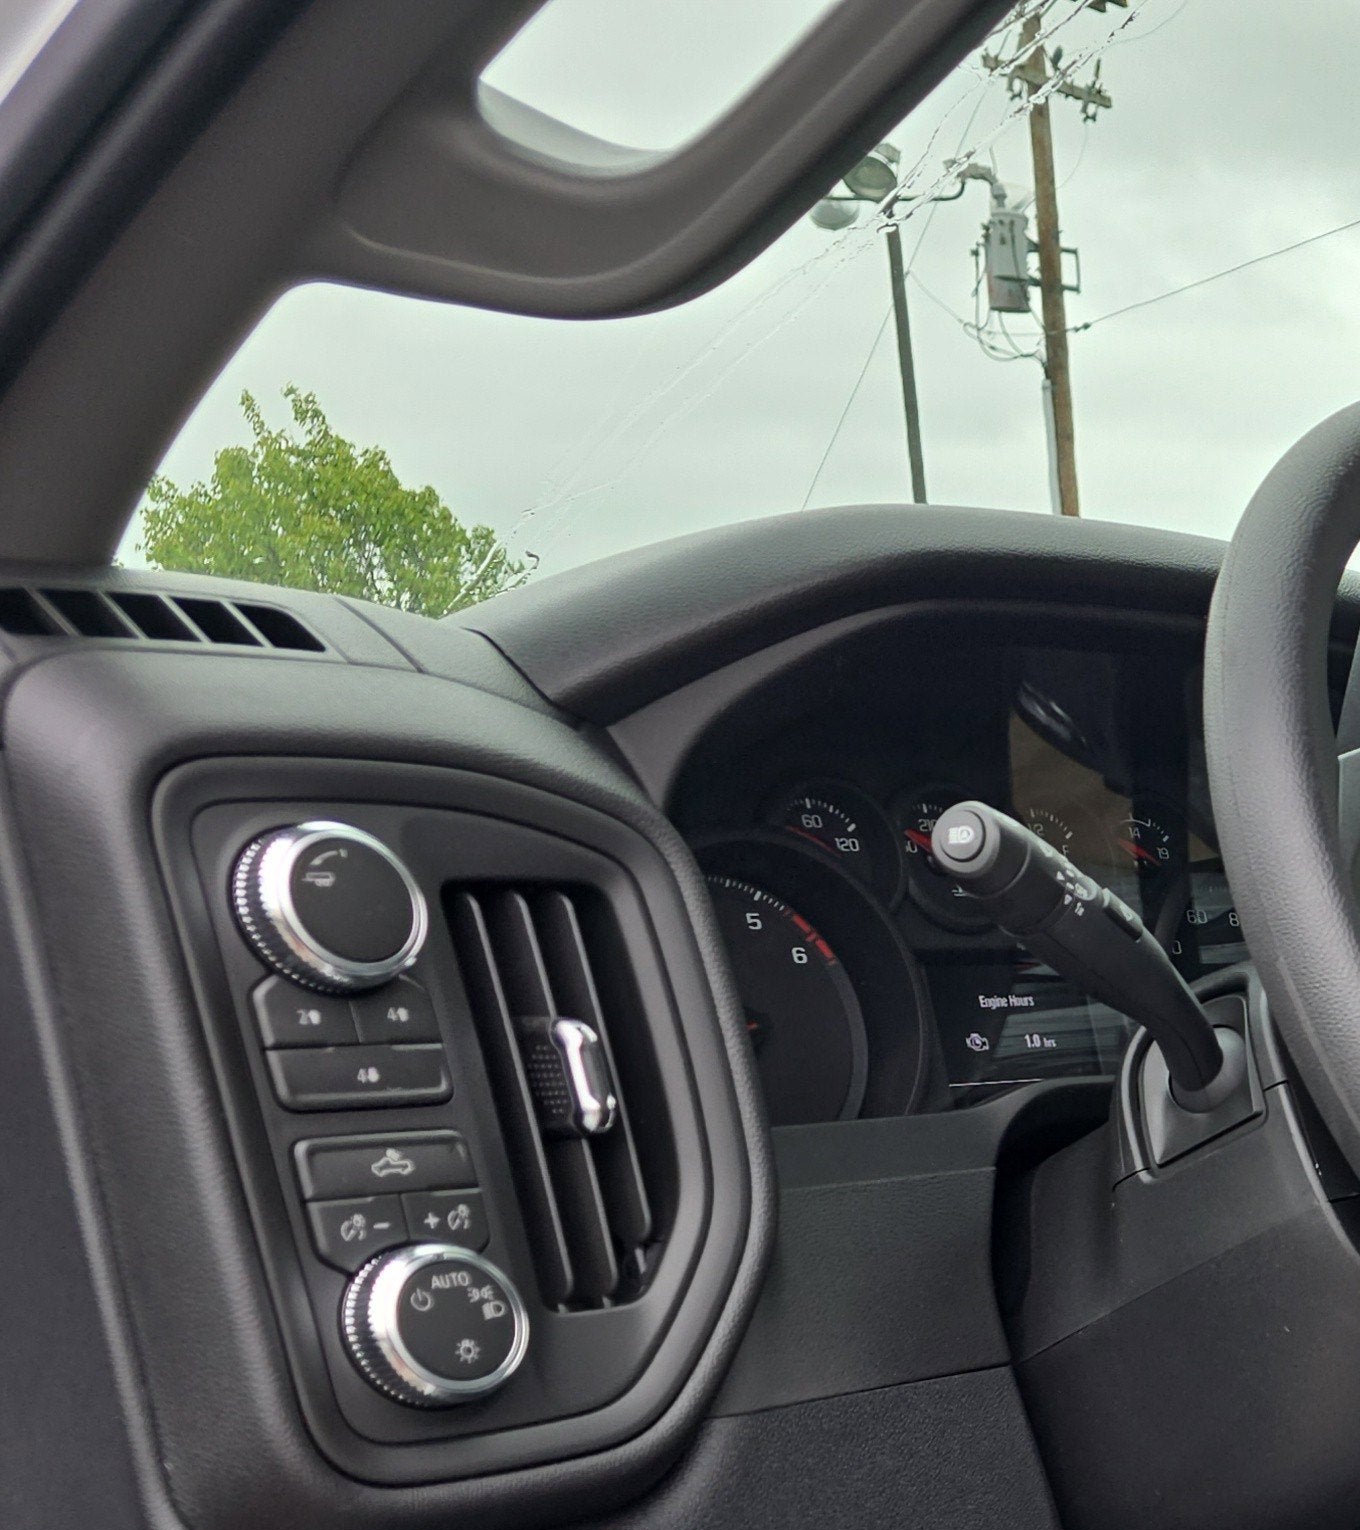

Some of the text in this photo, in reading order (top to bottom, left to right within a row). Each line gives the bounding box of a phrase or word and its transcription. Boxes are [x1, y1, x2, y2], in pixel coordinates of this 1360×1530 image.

[801, 814, 823, 828] 60
[834, 837, 860, 852] 120
[745, 912, 762, 930] 5
[1186, 909, 1208, 925] 60
[791, 947, 808, 964] 6
[978, 995, 1035, 1010] Engine Hours
[1024, 1033, 1057, 1048] 1.0 hrs
[431, 1271, 470, 1289] AUTO
